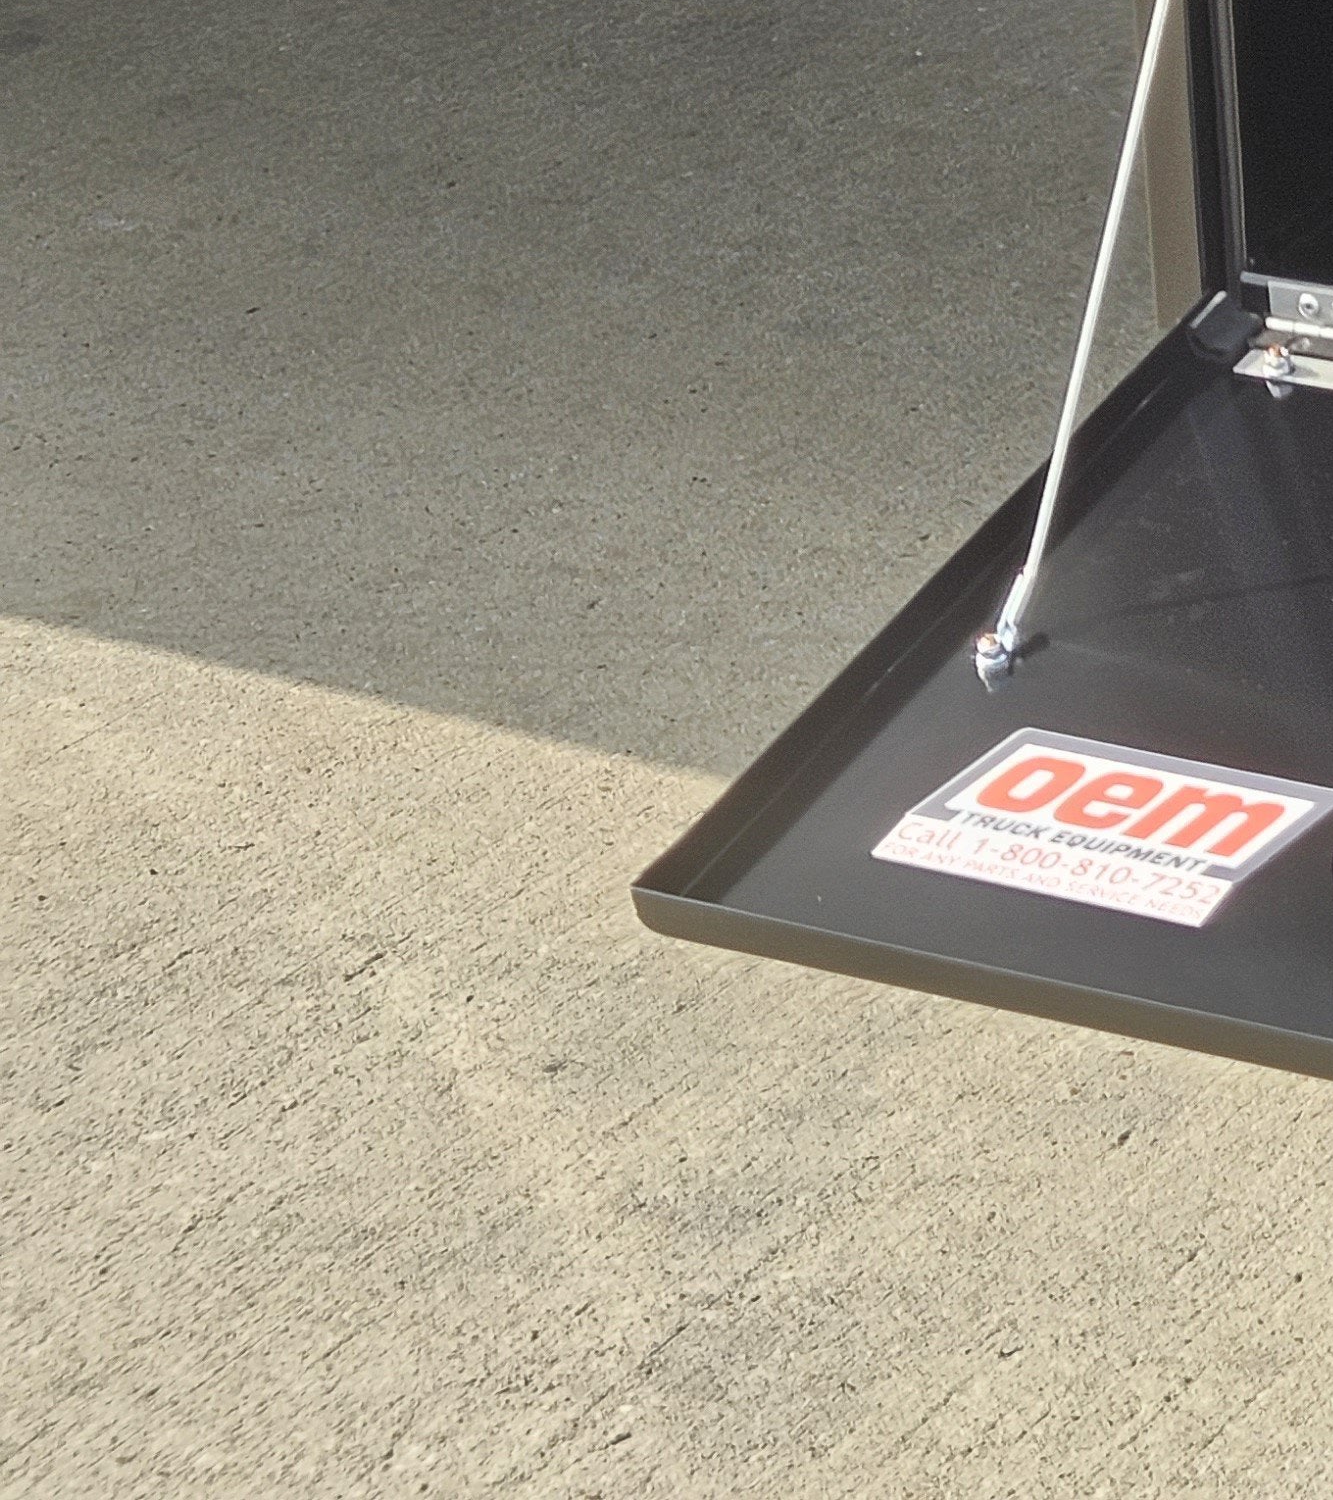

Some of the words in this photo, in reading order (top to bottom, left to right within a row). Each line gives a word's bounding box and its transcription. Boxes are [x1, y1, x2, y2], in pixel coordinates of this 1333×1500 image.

[961, 810, 1051, 839] TRUCK
[1050, 830, 1207, 871] EQUIPMENT
[976, 755, 1286, 858] oem
[884, 841, 918, 858] FOR
[920, 850, 960, 865] ANY
[964, 858, 1020, 879] PARTS
[898, 821, 962, 849] Call
[973, 837, 1221, 905] 1-800-810-7252
